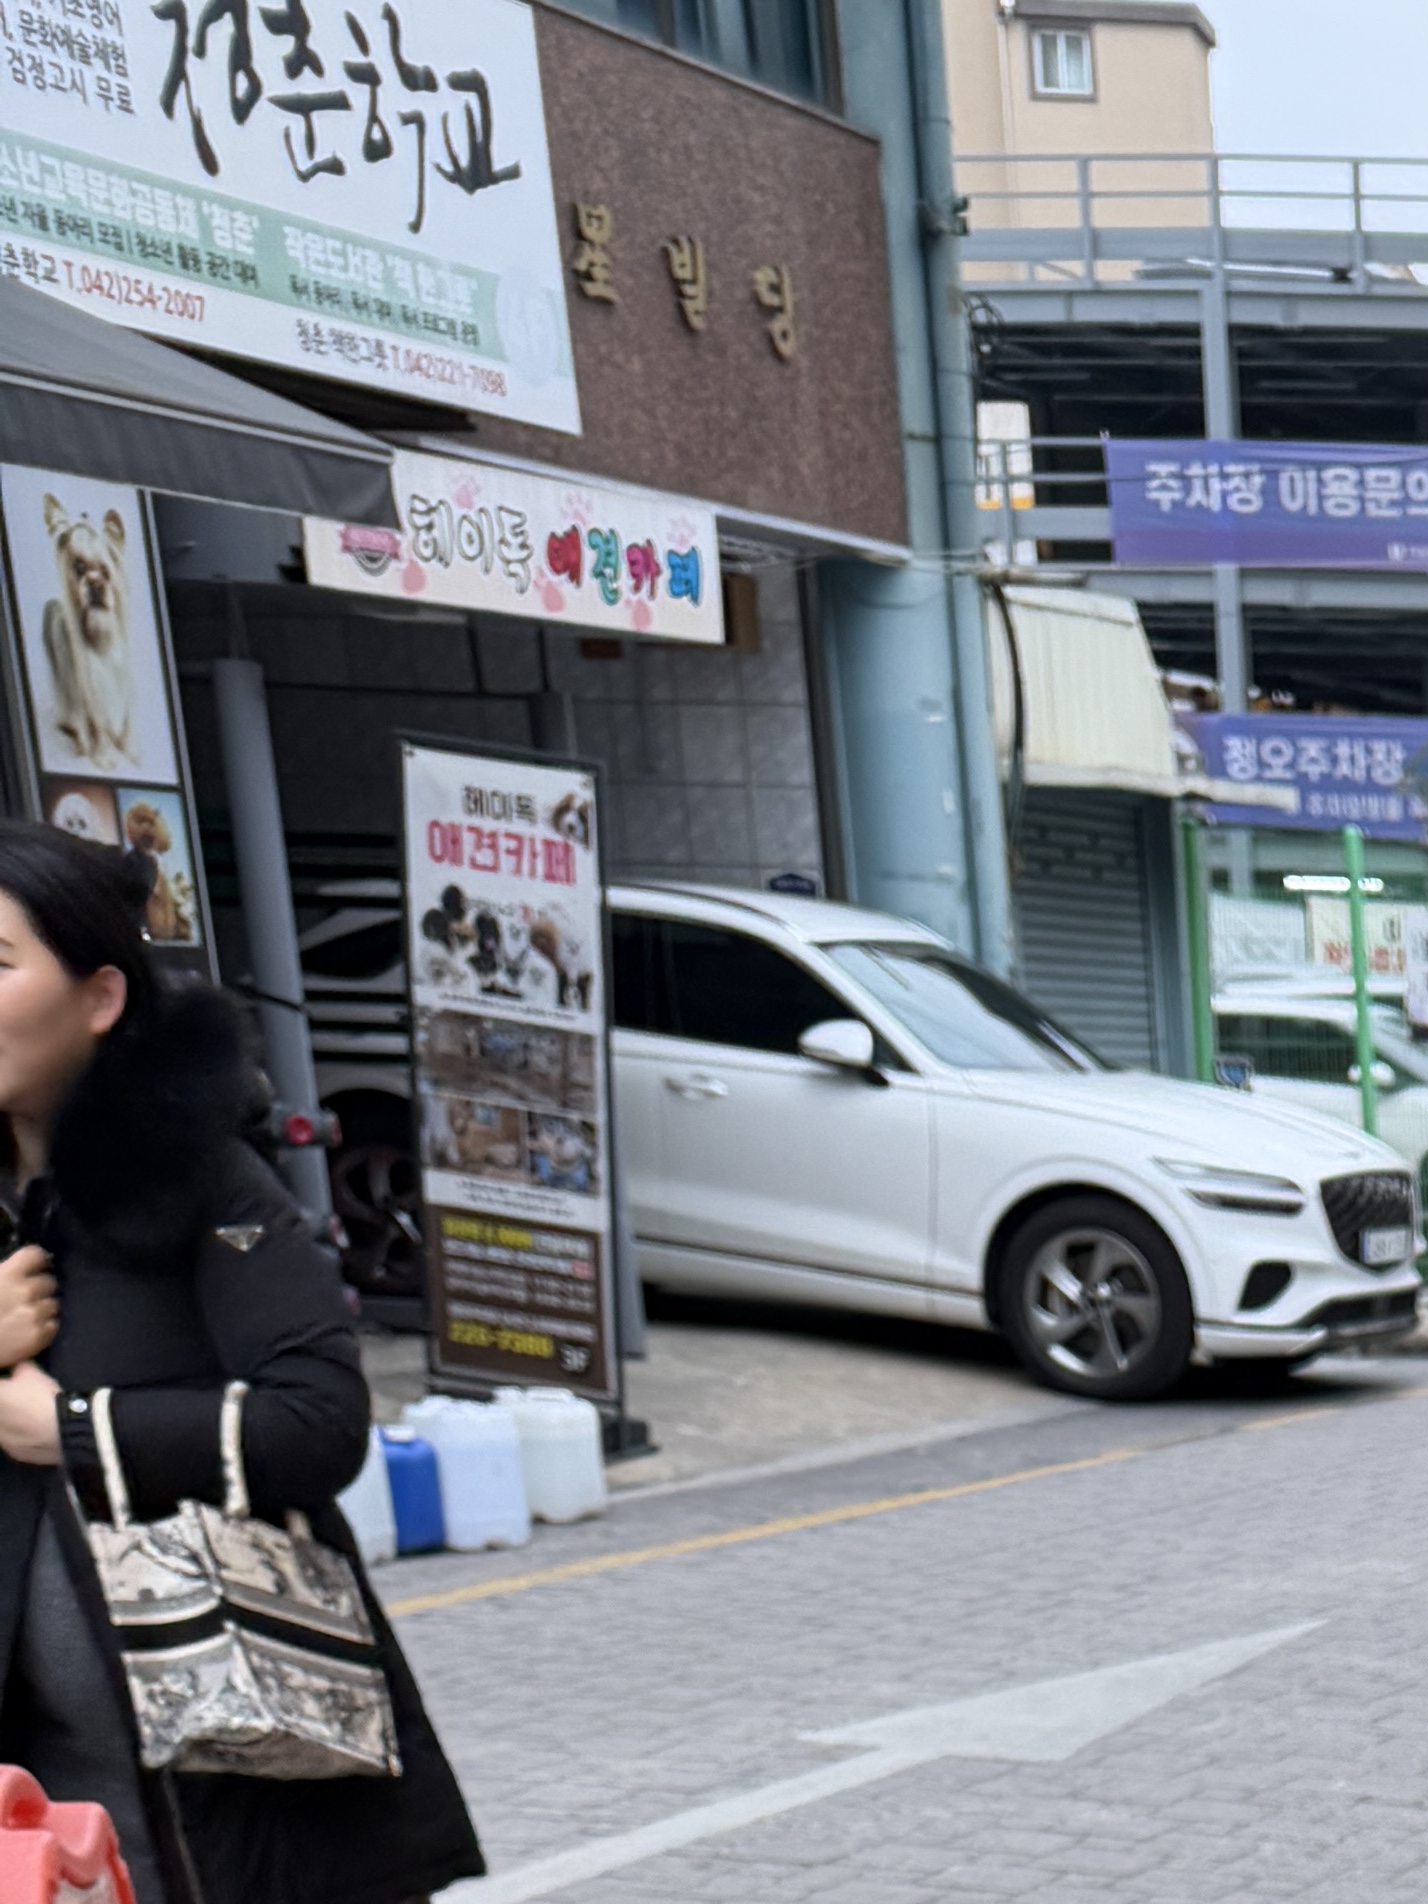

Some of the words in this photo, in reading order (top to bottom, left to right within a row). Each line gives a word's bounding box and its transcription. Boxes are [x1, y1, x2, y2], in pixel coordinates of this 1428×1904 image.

[5, 46, 88, 105] 검정고시
[96, 75, 136, 116] 무료
[1144, 461, 1266, 515] 주차장
[546, 523, 701, 607] 애견카페
[427, 819, 577, 888] 애견카페
